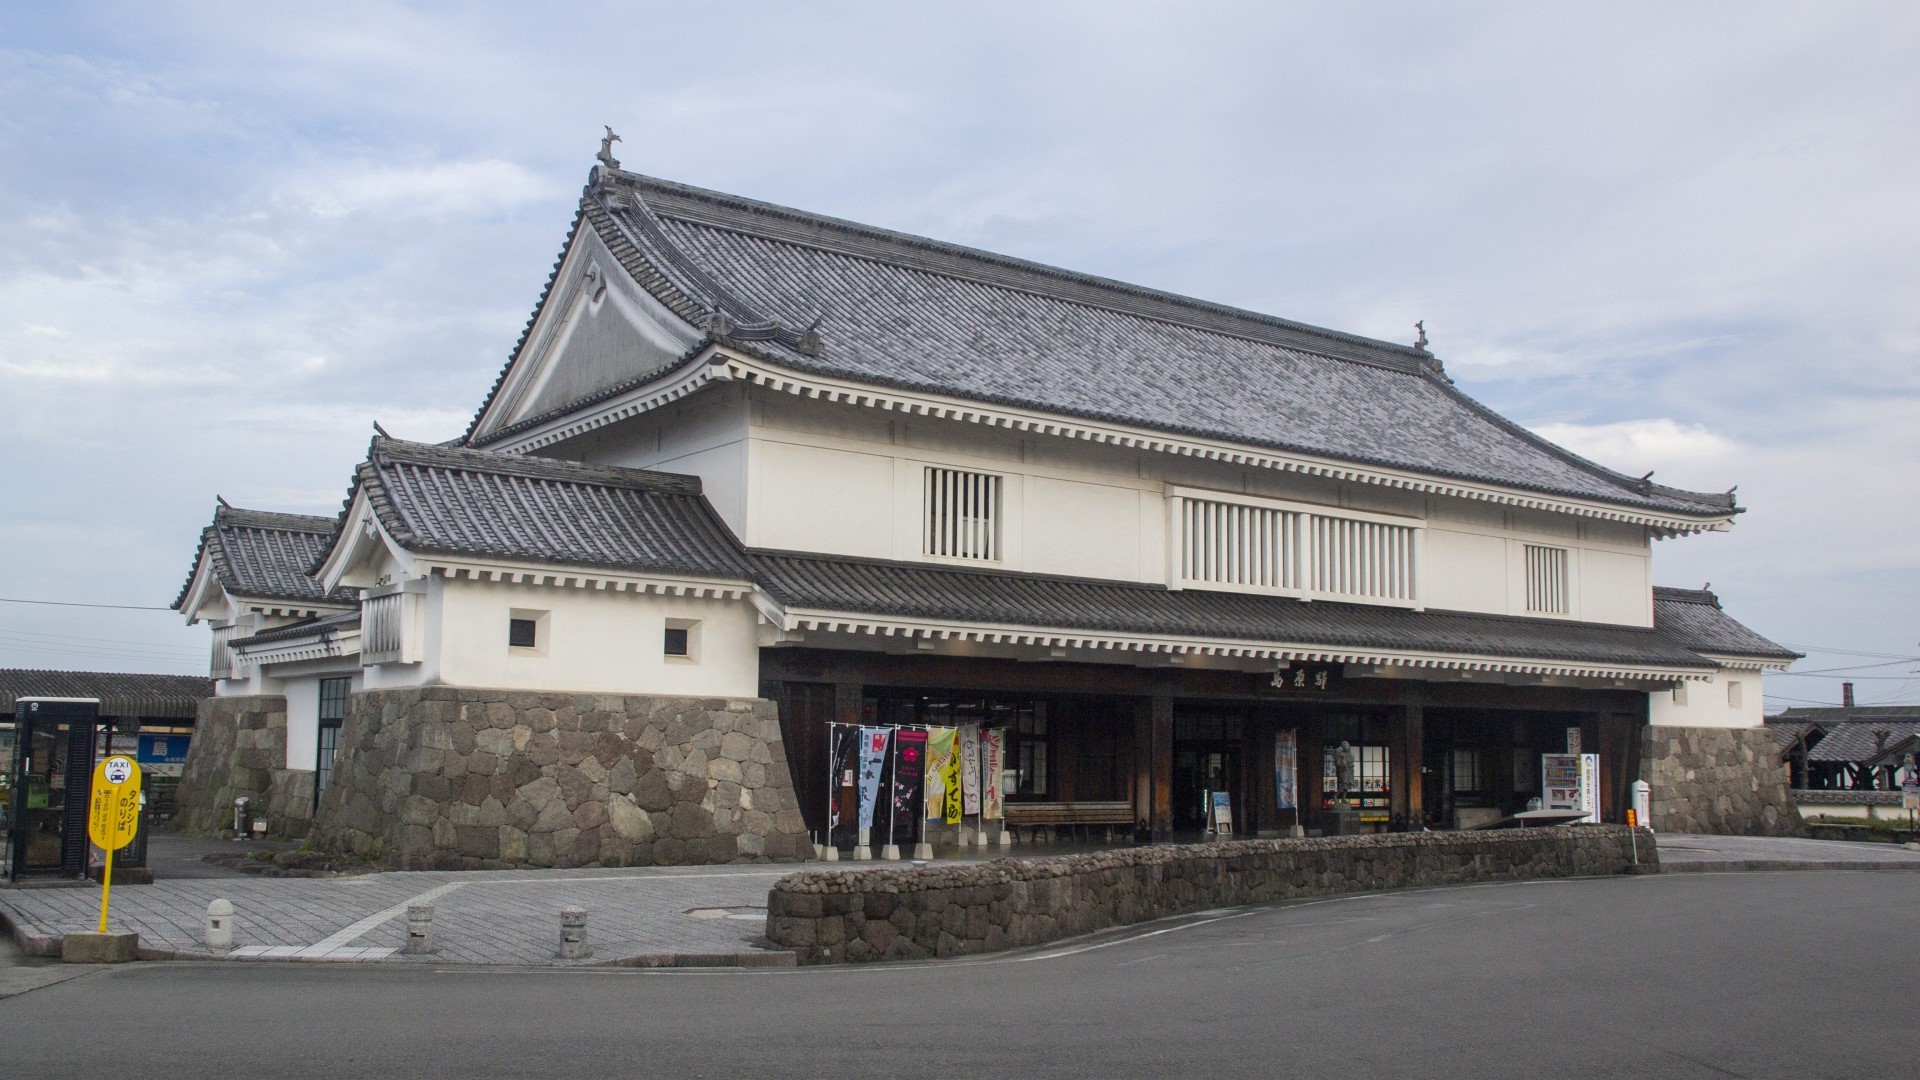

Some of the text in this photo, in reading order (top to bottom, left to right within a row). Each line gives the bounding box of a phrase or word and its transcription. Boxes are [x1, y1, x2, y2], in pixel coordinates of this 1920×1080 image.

[931, 751, 952, 773] Gelato
[118, 798, 128, 831] のりば
[127, 789, 137, 836] タクシー
